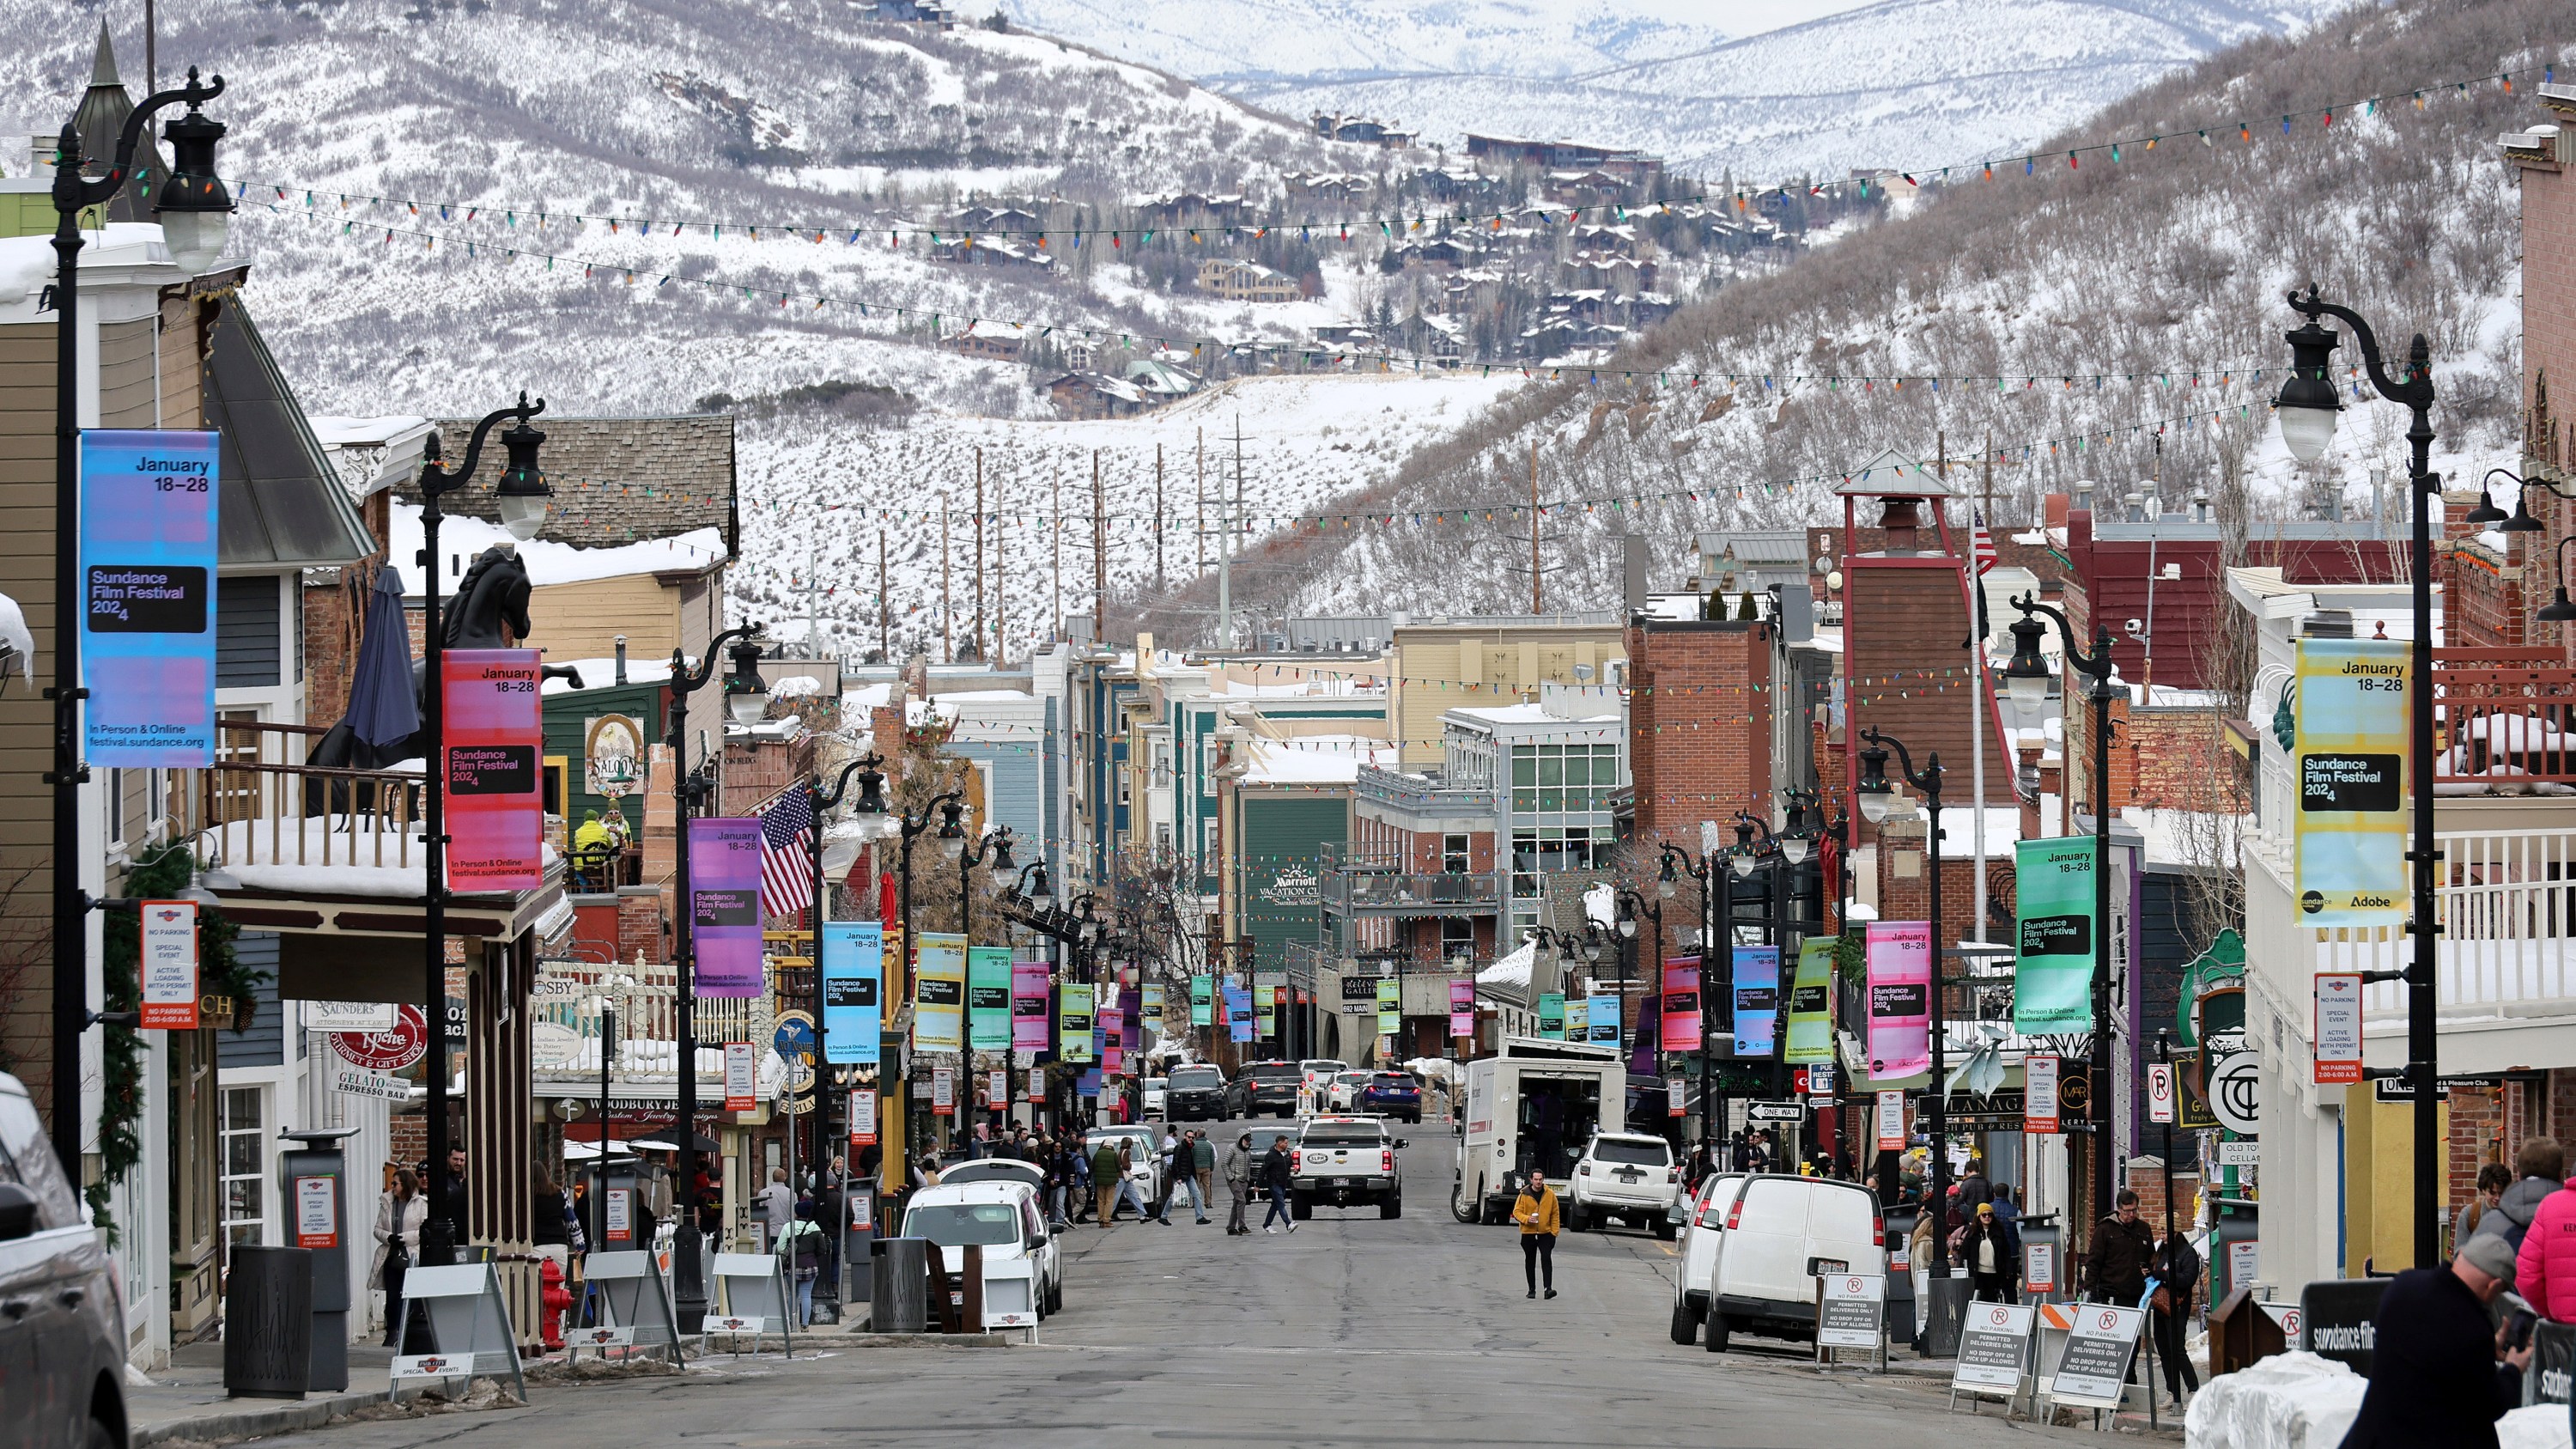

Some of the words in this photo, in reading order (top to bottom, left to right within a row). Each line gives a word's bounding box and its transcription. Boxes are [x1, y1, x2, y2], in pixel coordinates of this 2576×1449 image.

[136, 456, 210, 476] January
[155, 477, 209, 492] 18–28
[92, 570, 168, 584] Sundance
[92, 586, 125, 599] Film
[127, 587, 184, 600] Festival
[92, 600, 129, 621] 2024
[482, 667, 535, 680] January
[2342, 661, 2404, 678] January
[495, 682, 535, 692] 18–28
[2358, 679, 2403, 691] 18–28
[89, 725, 99, 734] In
[100, 725, 137, 734] Person
[140, 725, 148, 734] &
[149, 725, 185, 734] Online
[89, 737, 204, 748] festival.sundance.org
[452, 750, 507, 760] Sundance
[453, 761, 475, 771] Film
[477, 759, 519, 770] Festival
[592, 756, 639, 776] SALOON
[2305, 758, 2367, 770] Sundance
[453, 771, 479, 787] 2024
[2306, 771, 2331, 782] Film
[2334, 771, 2380, 782] Festival
[2306, 784, 2336, 801] 2024
[718, 831, 757, 842] January
[2048, 852, 2091, 862] January
[452, 868, 536, 877] festival.sundance.org
[2059, 862, 2091, 874] 18–28
[1273, 876, 1316, 888] Marriott
[2350, 897, 2391, 907] Adobe
[696, 909, 716, 921] 2024
[2024, 919, 2067, 930] Sundance
[847, 932, 878, 941] January
[1892, 933, 1926, 942] January
[2025, 930, 2042, 939] Film
[2044, 927, 2077, 936] Festival
[2024, 939, 2044, 949] 2024
[532, 980, 574, 996] OSBY
[828, 993, 844, 1002] 2024
[200, 995, 233, 1014] CH
[1874, 1002, 1891, 1012] 2024
[322, 1005, 375, 1017] SAUNDERS
[2018, 1015, 2087, 1024] festival.sundance.org
[330, 1032, 365, 1065] OURMET
[376, 1057, 398, 1068] GIFT
[401, 1041, 423, 1065] SHOP
[339, 1071, 386, 1088] GELATO
[337, 1083, 383, 1096] ESPRESSO
[387, 1090, 405, 1099] BAR
[590, 1099, 662, 1110] WODBURY
[1950, 1097, 2021, 1112] LANAG
[635, 1110, 676, 1122] Jewelry
[1781, 1108, 1797, 1117] WAY
[1962, 1123, 1984, 1131] PUB
[2314, 1323, 2360, 1350] sundance
[2083, 1340, 2116, 1349] PERMITTED
[2073, 1346, 2105, 1355] DELIVERIES
[2105, 1349, 2122, 1358] ONLY
